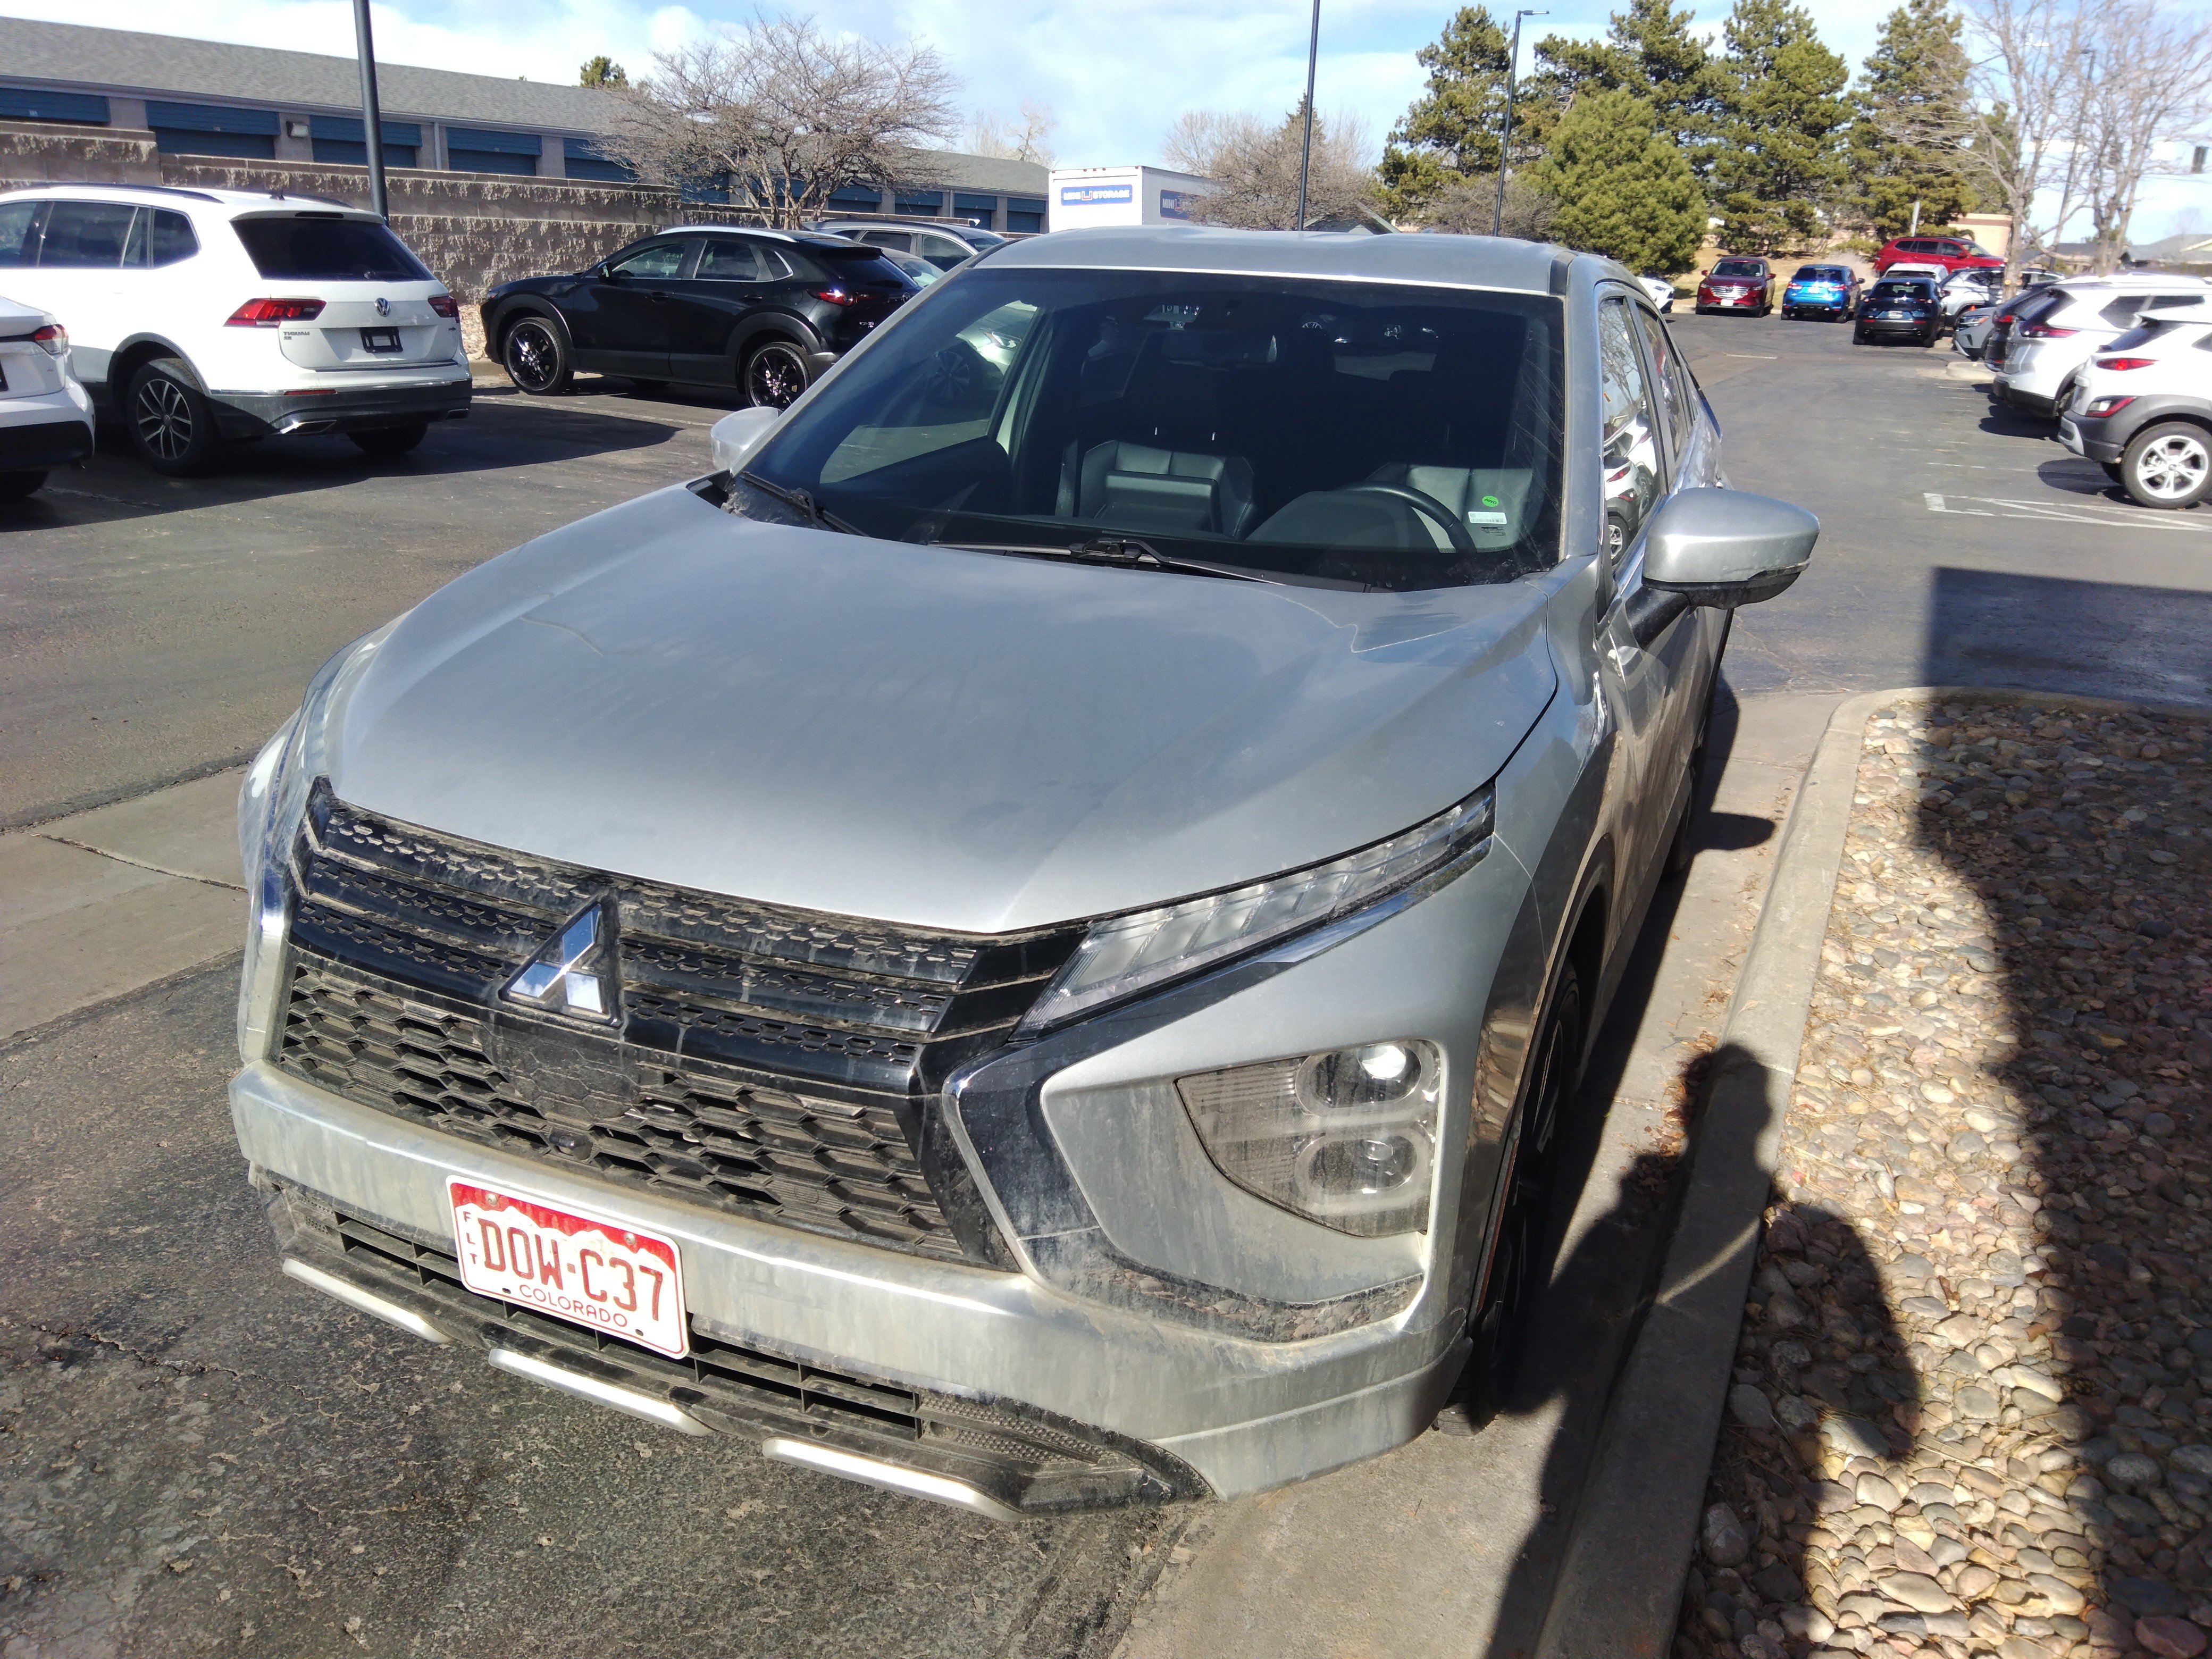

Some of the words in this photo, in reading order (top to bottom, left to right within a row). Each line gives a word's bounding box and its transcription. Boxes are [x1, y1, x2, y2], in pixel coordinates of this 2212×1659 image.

[1093, 189, 1130, 199] STORAGE
[1162, 198, 1174, 210] MINI
[478, 1218, 663, 1321] DOW-C37
[520, 1284, 627, 1327] COLORADO
